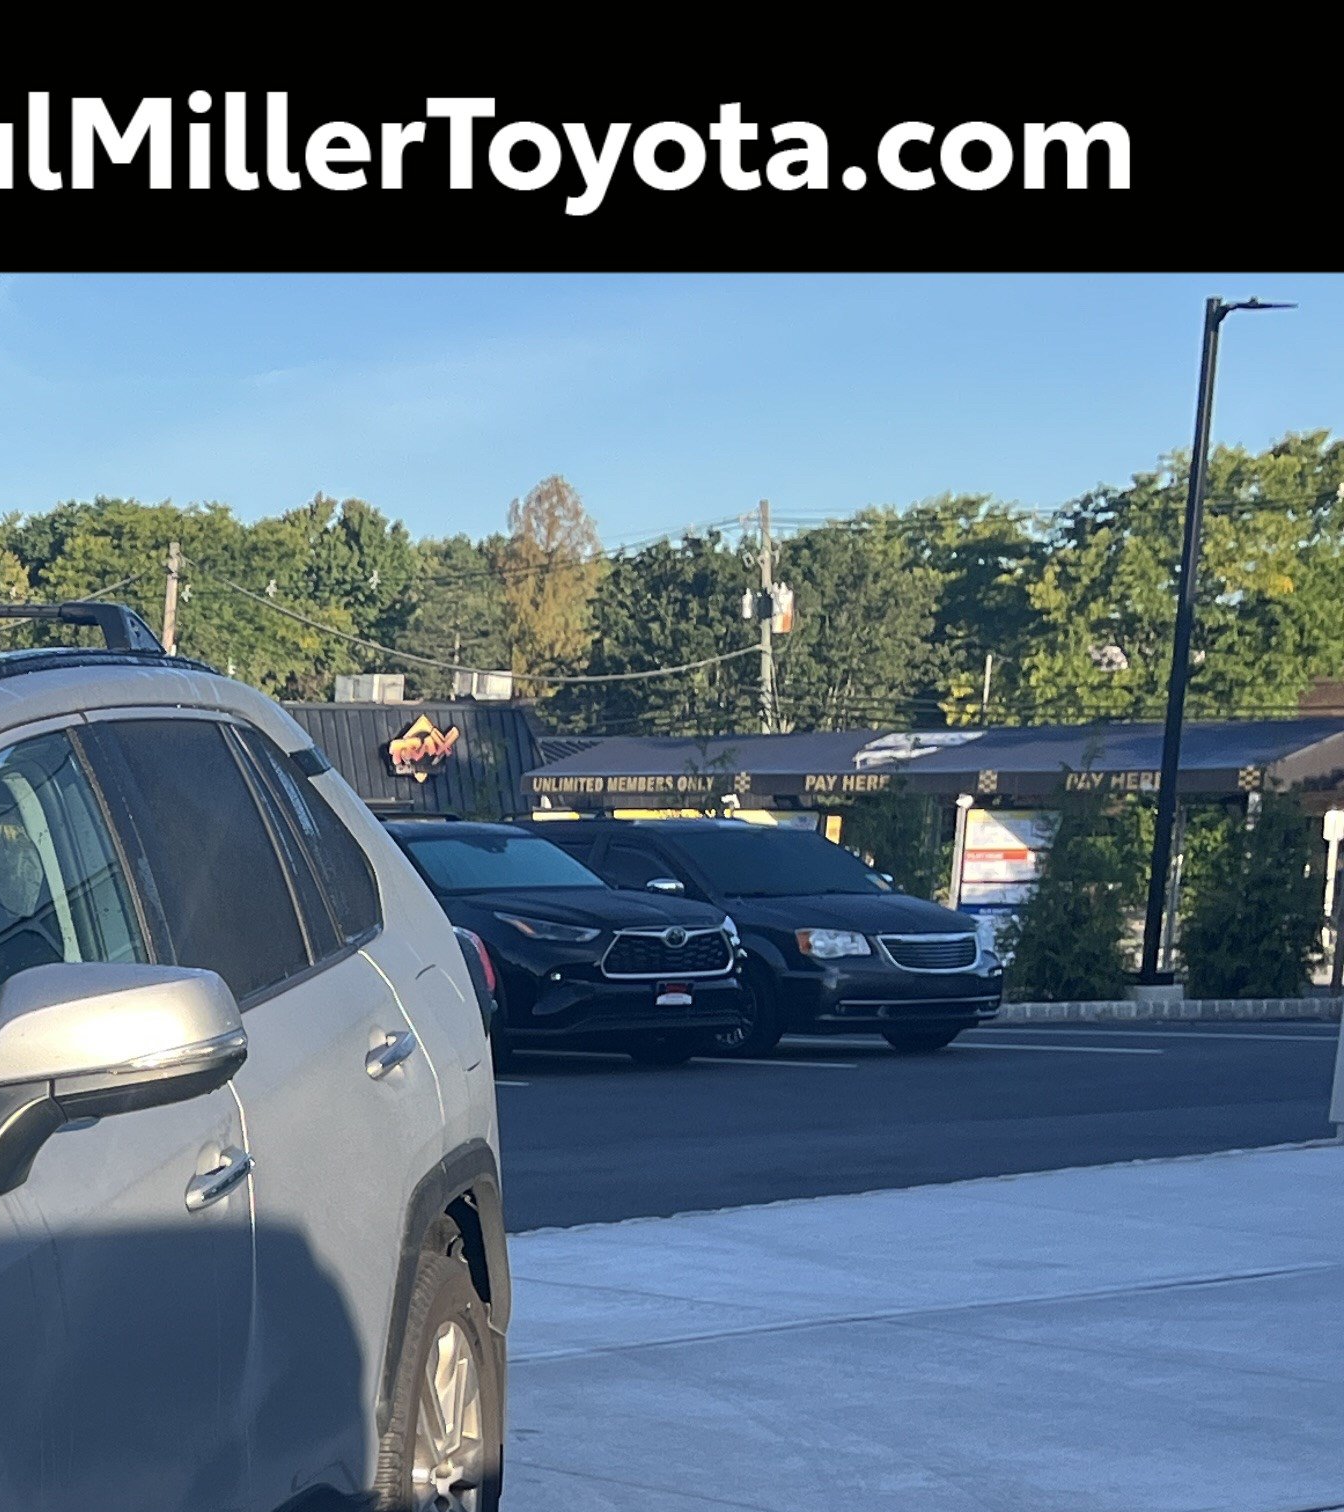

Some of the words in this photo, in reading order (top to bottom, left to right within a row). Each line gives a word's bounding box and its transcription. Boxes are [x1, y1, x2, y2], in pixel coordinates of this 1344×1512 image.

[532, 777, 603, 792] UNLIMITED
[607, 776, 674, 792] MEMBERS
[677, 776, 714, 792] ONLY
[805, 774, 837, 791] PAY
[1066, 772, 1104, 791] PAY
